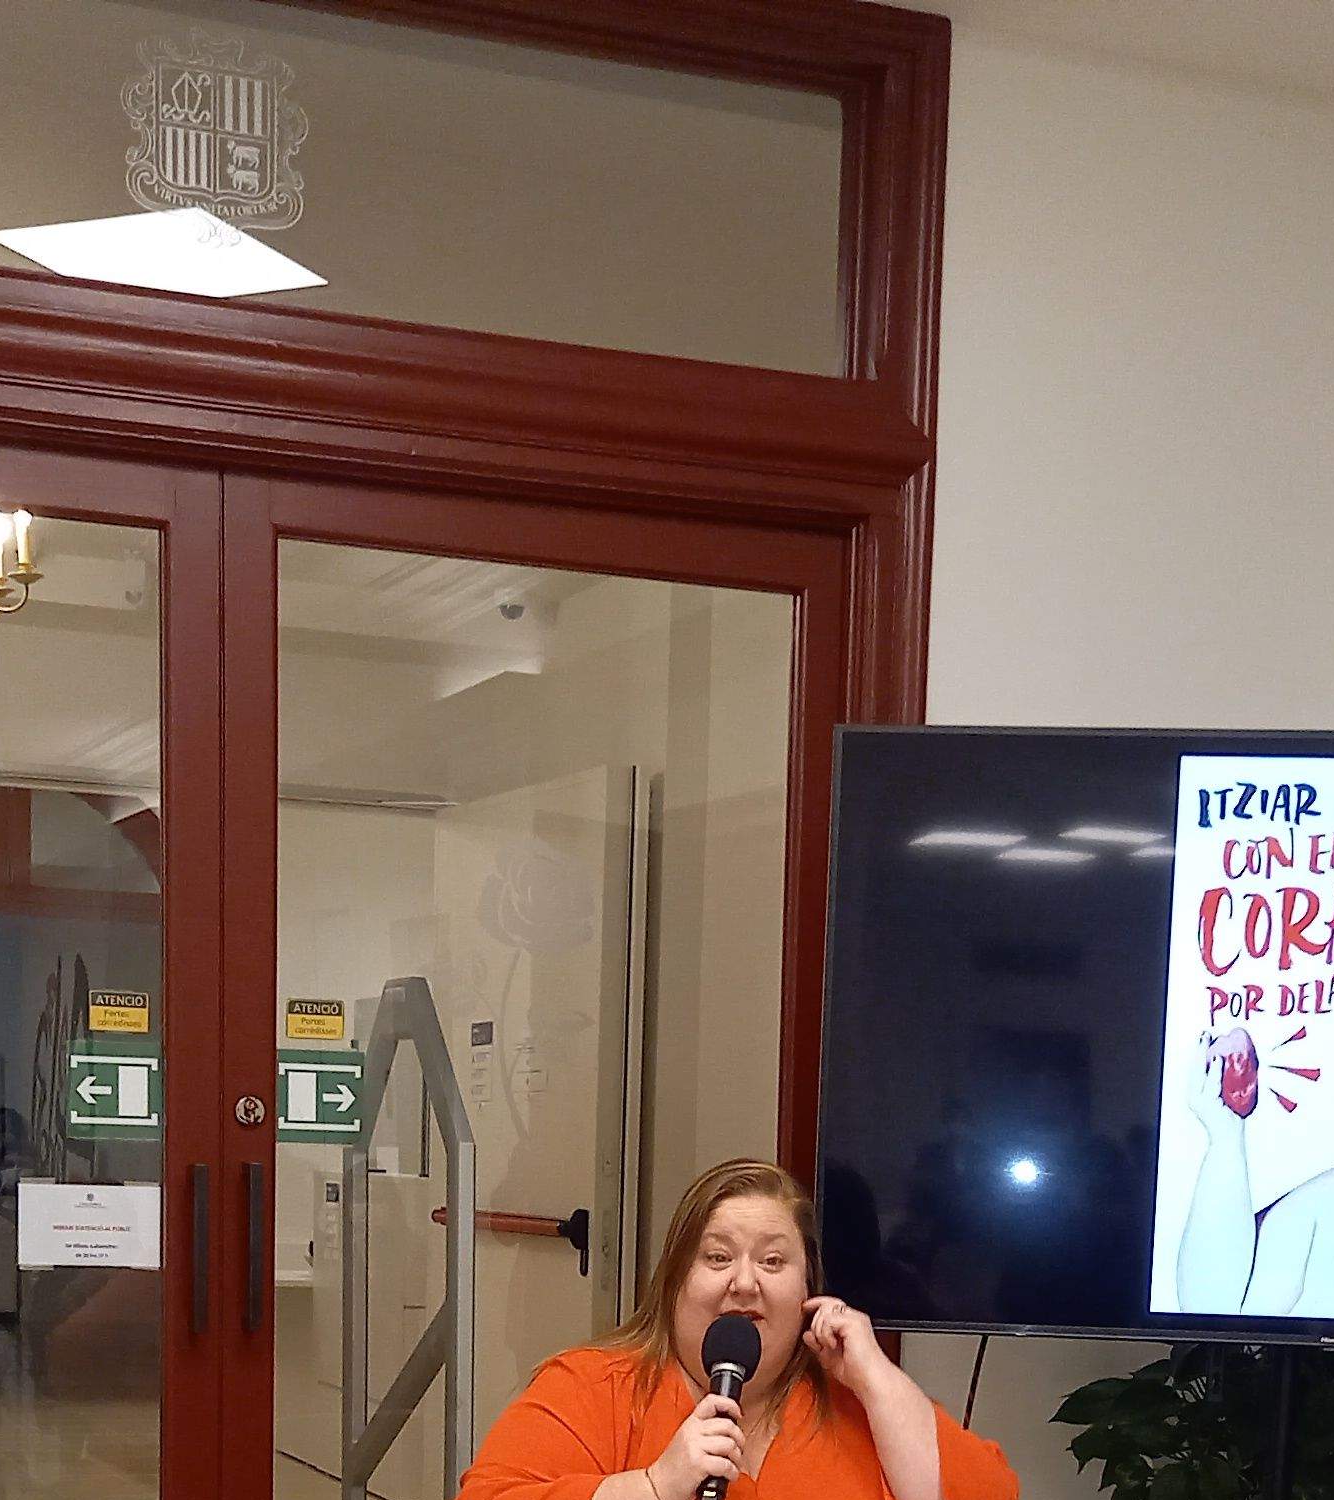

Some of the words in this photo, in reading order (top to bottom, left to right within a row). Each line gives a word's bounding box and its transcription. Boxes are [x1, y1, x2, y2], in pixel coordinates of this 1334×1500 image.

[1198, 782, 1321, 828] ITZIAR
[1223, 828, 1294, 880] CON
[1206, 984, 1265, 1027] POR
